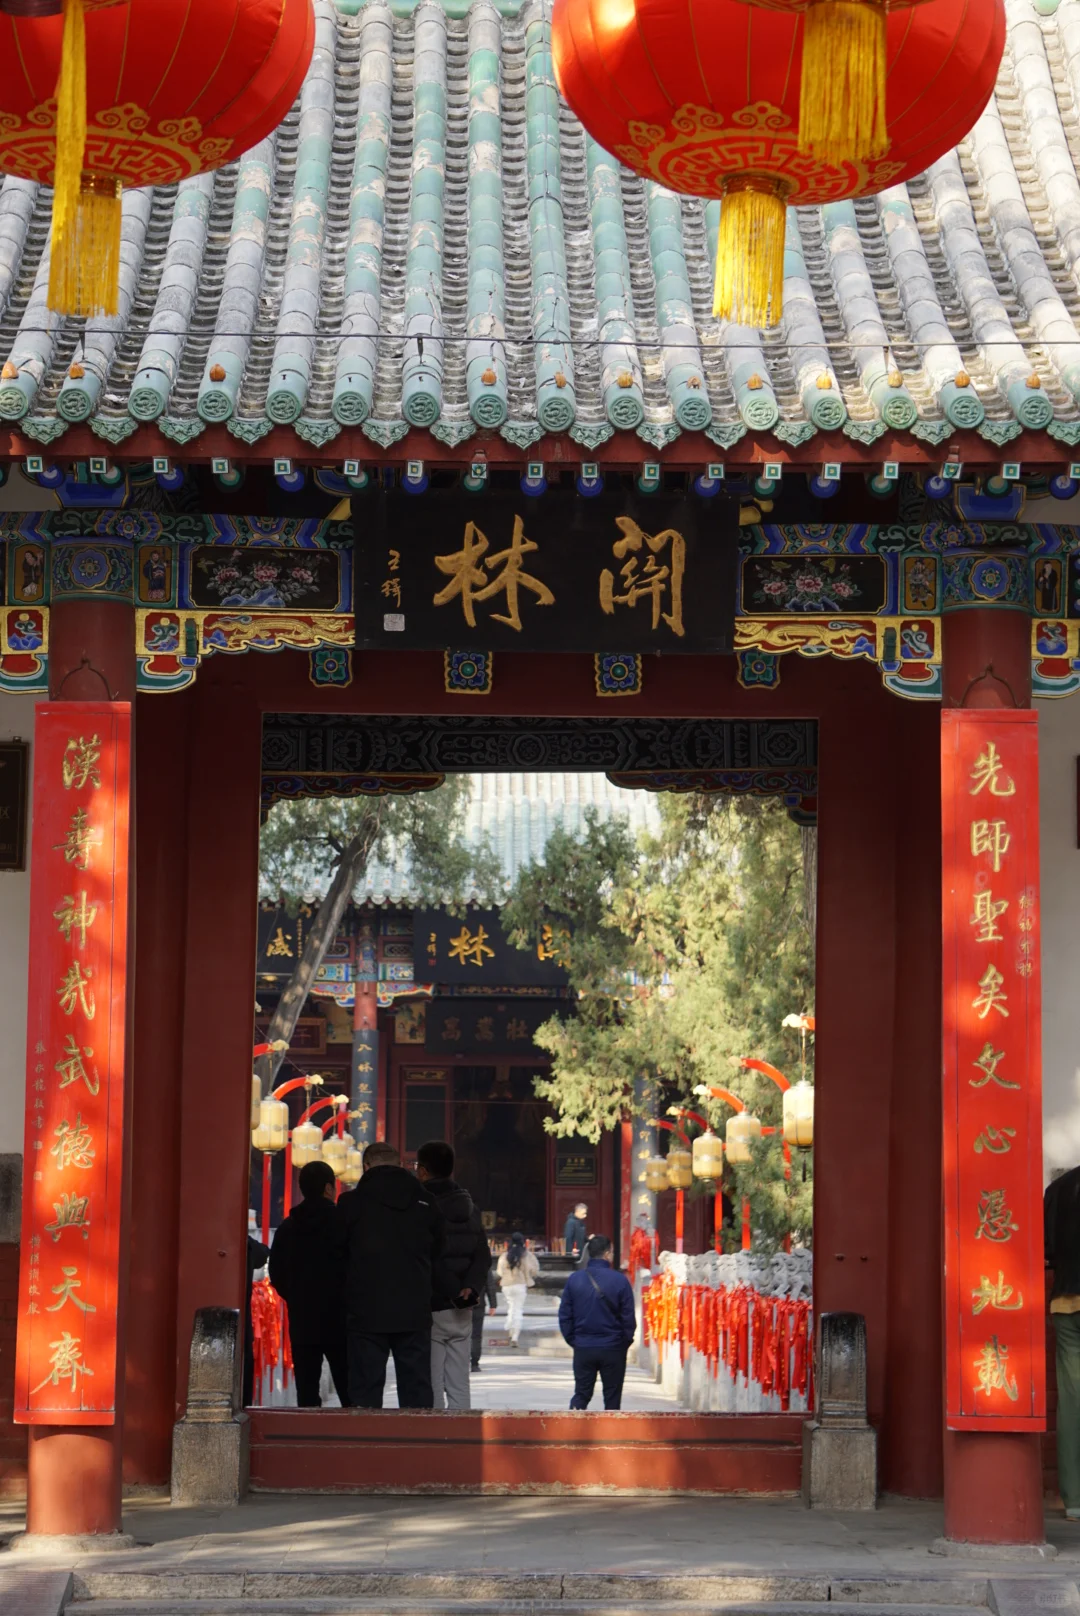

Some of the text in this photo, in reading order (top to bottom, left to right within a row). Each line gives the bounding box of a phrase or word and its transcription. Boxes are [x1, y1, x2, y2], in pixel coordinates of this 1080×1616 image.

[433, 514, 686, 637] 關林
[968, 741, 1023, 1401] 先師聖矣文心憑地載
